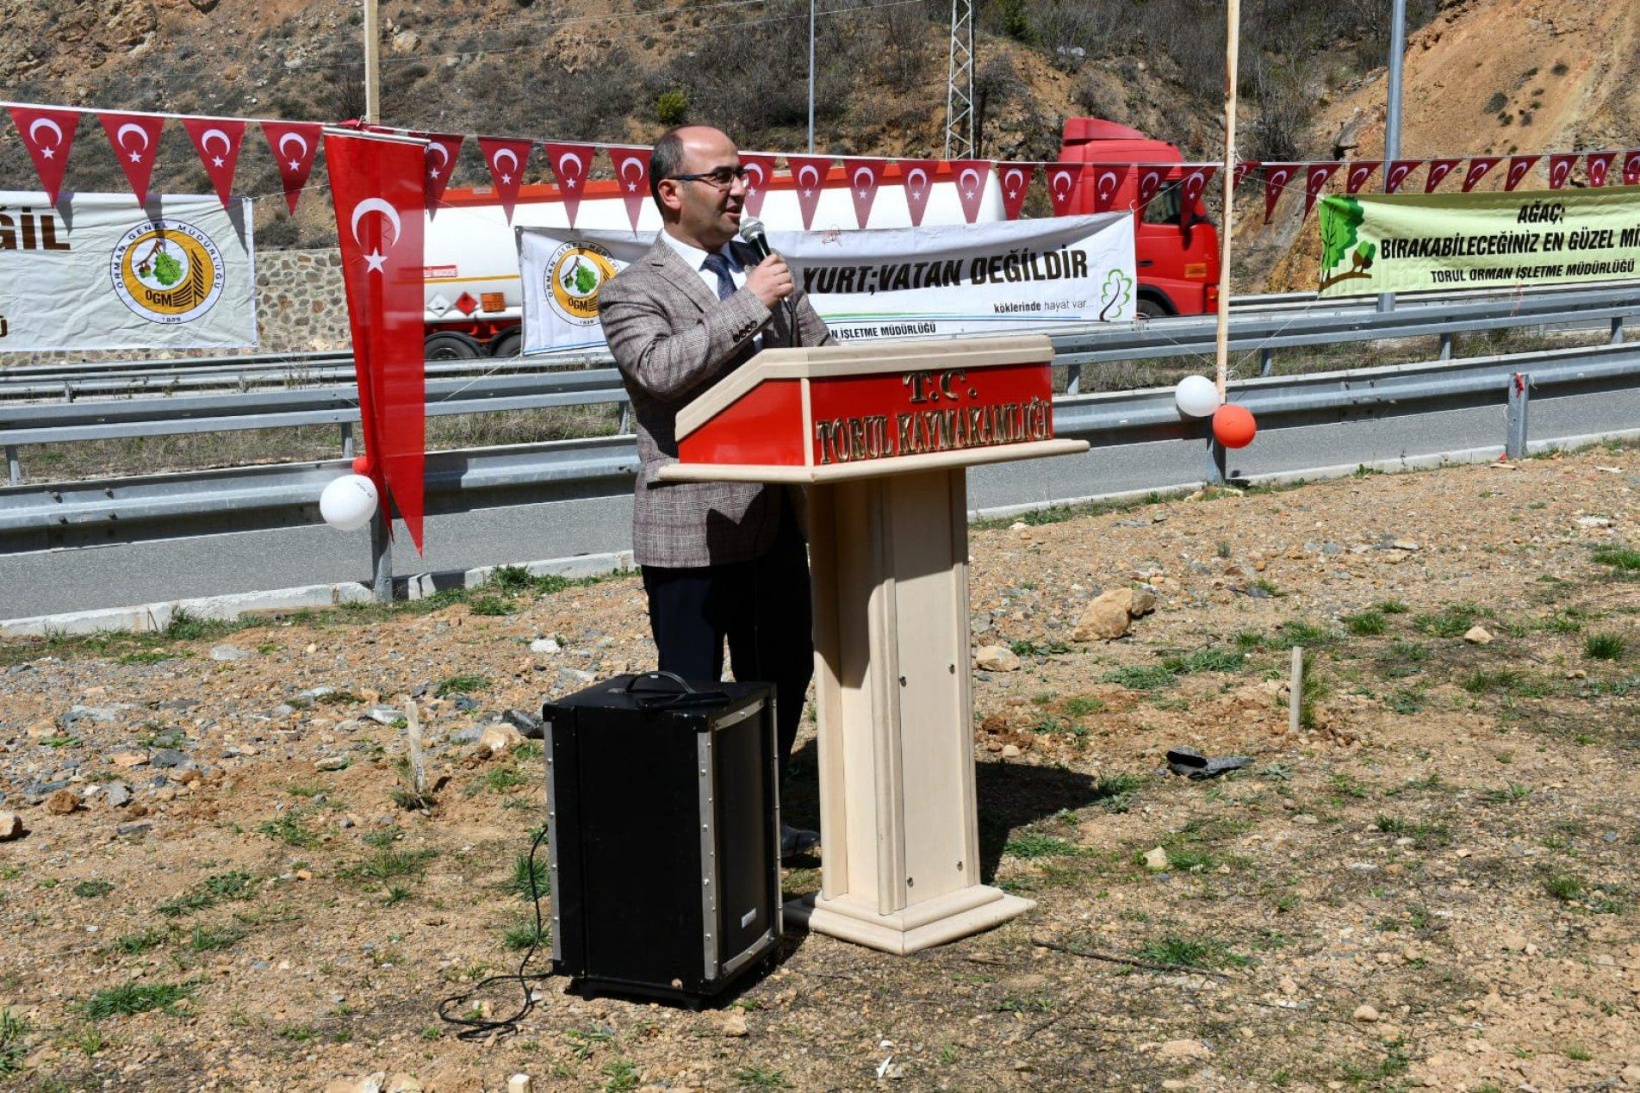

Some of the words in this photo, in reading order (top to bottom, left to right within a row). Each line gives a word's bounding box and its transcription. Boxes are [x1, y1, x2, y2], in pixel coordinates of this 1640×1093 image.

[1380, 229, 1540, 260] BIRAKABİLECEĞİNİZ
[1542, 231, 1565, 252] EN
[1568, 226, 1615, 251] GÜZEL
[1619, 223, 1640, 248] Mİ
[114, 245, 126, 289] ORMAN
[970, 245, 1088, 289] DEĞİLDİR
[1430, 269, 1467, 283] TORUL
[1469, 267, 1514, 281] ORMAN
[1515, 264, 1564, 280] İŞLETME
[1565, 258, 1635, 277] MÜDÜRLÜĞÜ
[145, 290, 173, 307] OGM
[568, 297, 588, 312] OGM
[994, 300, 1042, 313] köklerinde
[1044, 299, 1070, 312] hayat
[880, 321, 937, 336] MÜDÜRLÜĞÜ
[903, 370, 978, 403] T.C.
[815, 414, 894, 465] TORUL
[896, 395, 1052, 456] KAYMAKAMLIĞI
